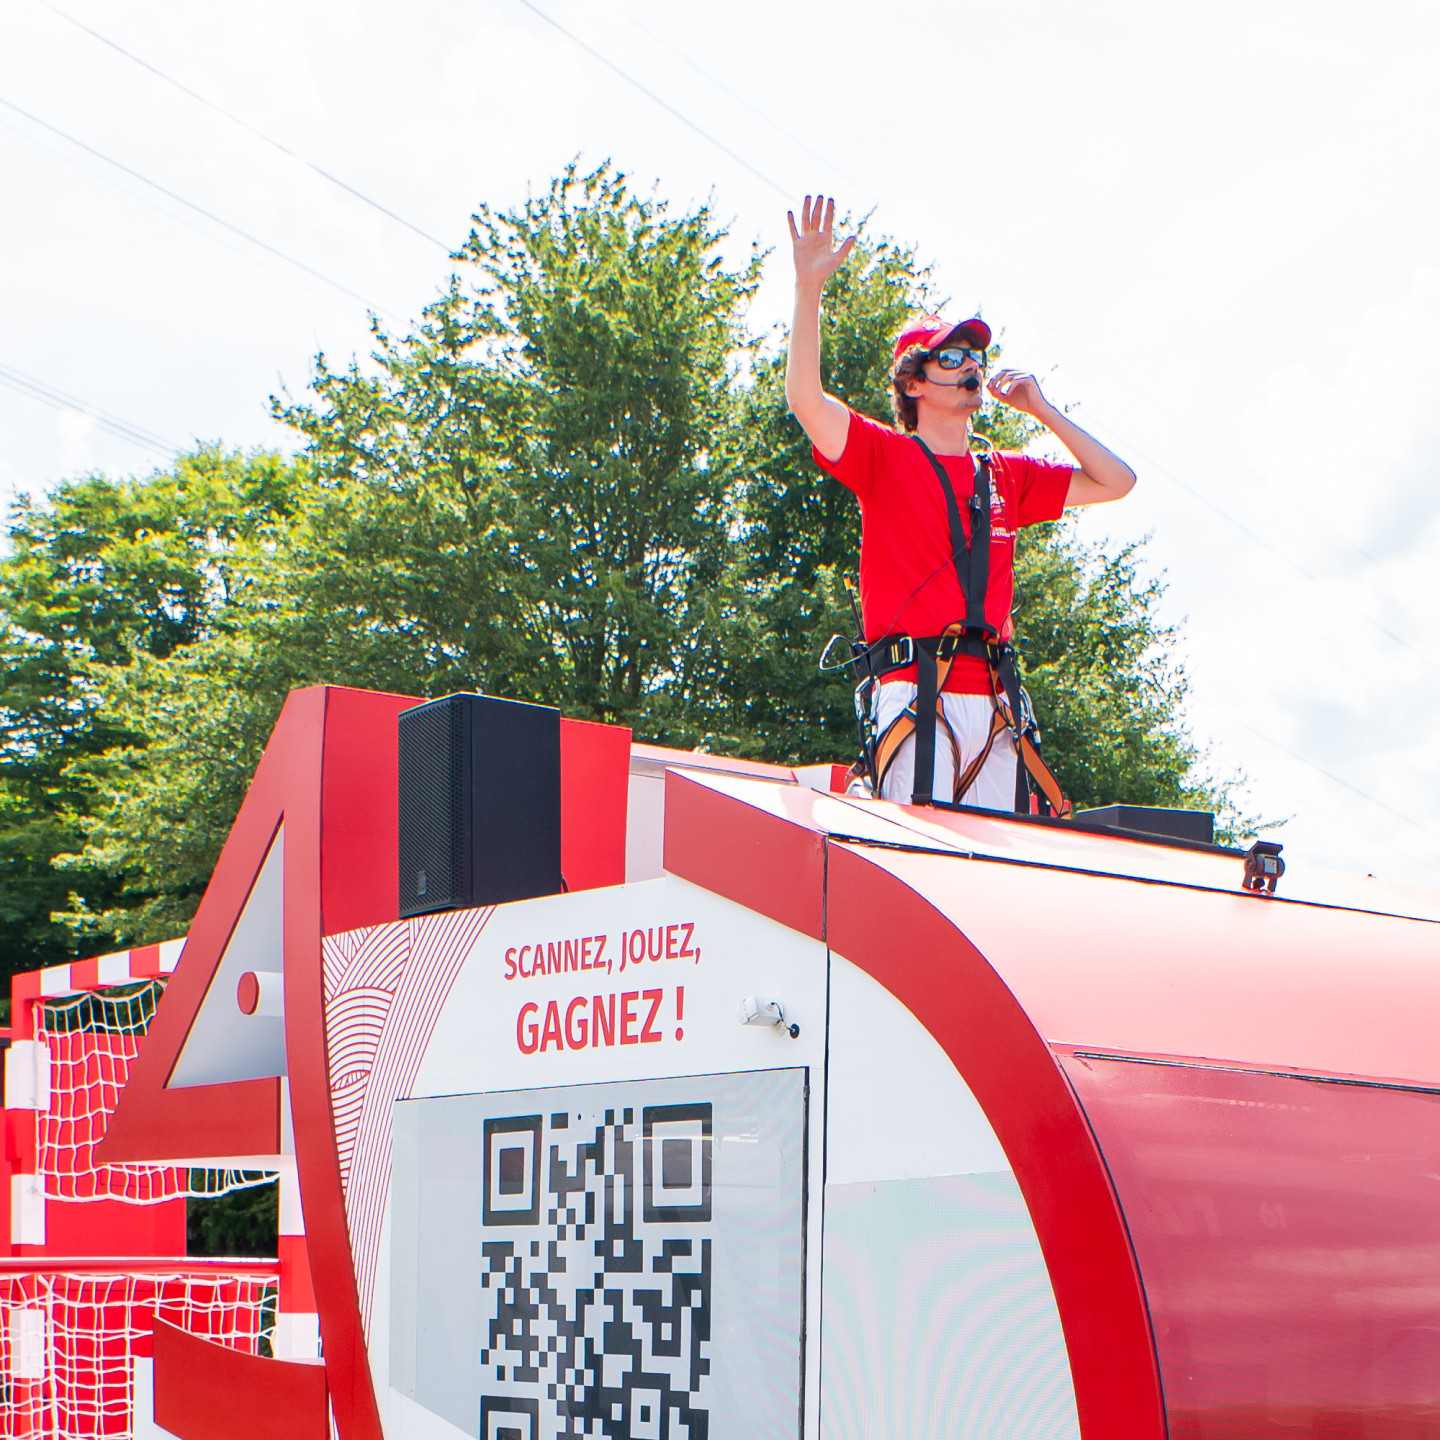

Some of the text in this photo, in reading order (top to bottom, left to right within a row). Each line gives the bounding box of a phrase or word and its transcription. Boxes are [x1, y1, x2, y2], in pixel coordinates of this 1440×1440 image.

[504, 922, 701, 981] SCANNEZ, JOUEZ,
[516, 986, 685, 1055] GAGNEZ !
